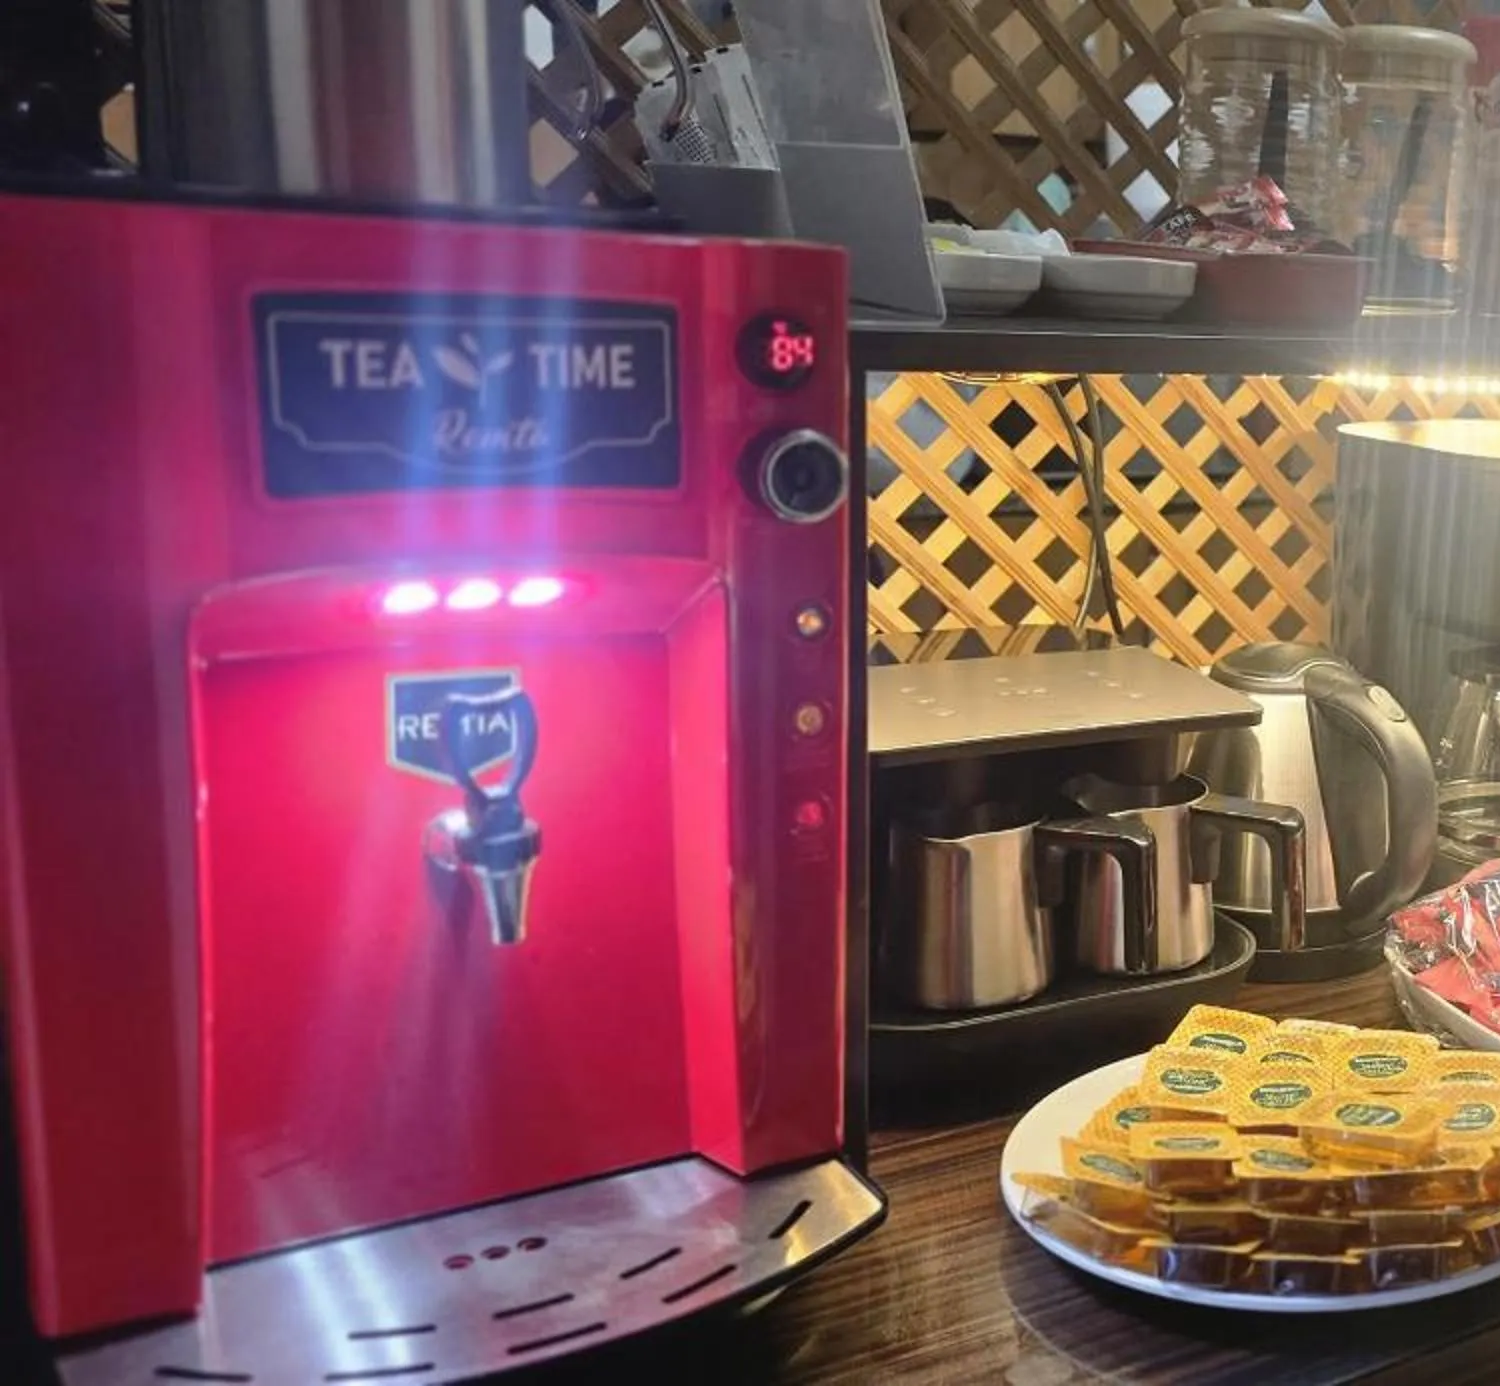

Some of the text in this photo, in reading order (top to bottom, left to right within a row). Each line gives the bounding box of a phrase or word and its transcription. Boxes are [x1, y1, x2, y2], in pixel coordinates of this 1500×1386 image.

[319, 338, 636, 389] TEA TIME
[772, 335, 814, 371] 84
